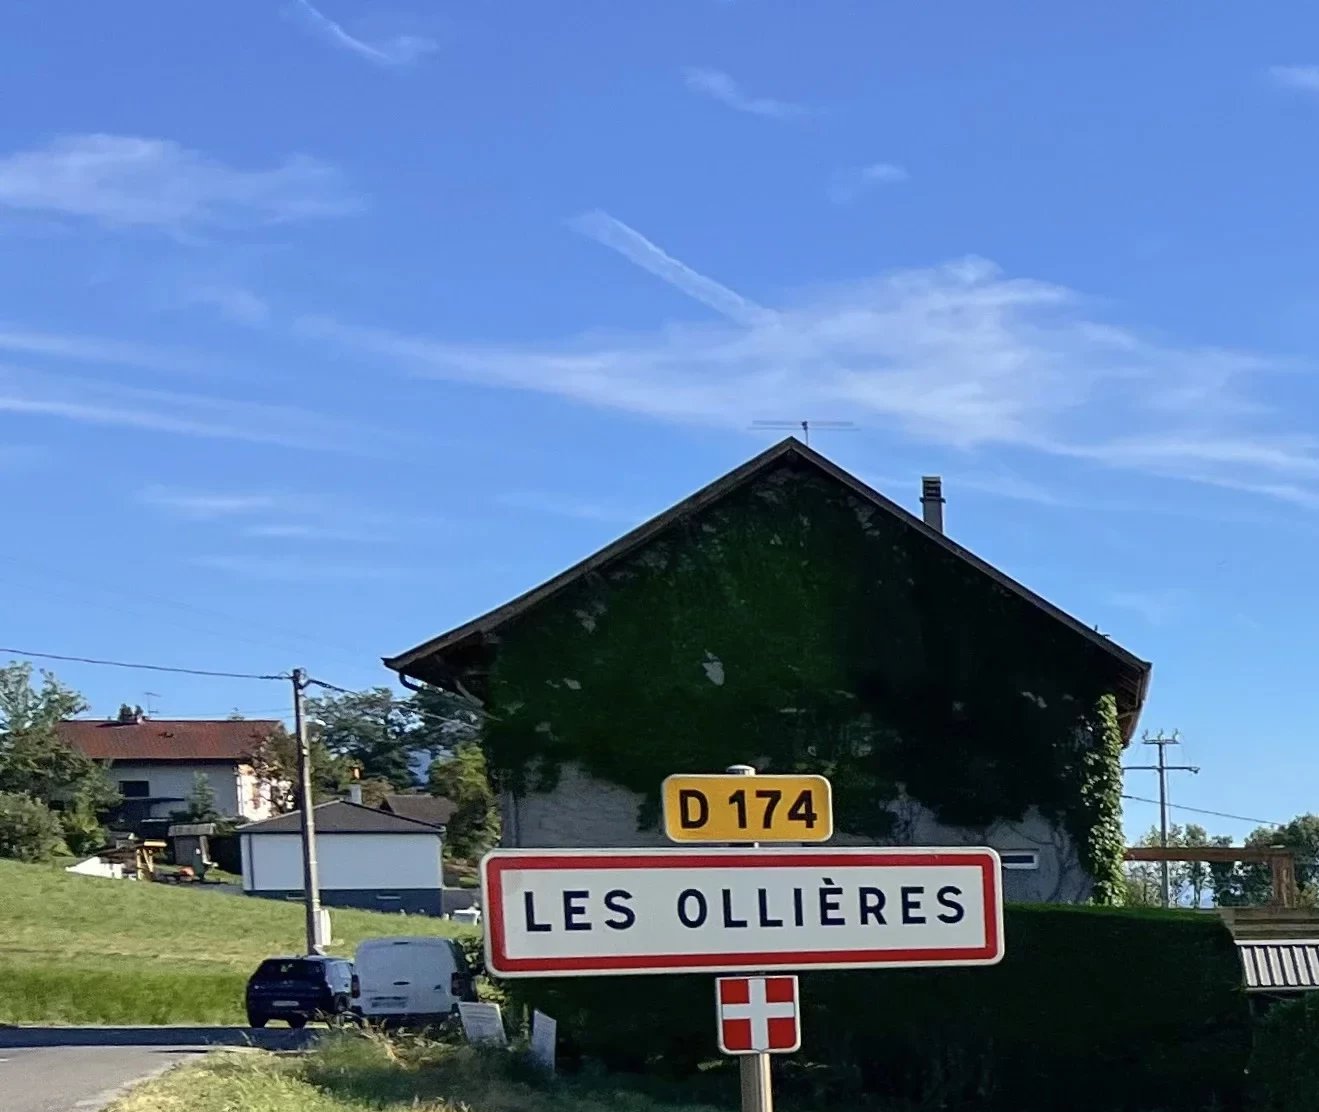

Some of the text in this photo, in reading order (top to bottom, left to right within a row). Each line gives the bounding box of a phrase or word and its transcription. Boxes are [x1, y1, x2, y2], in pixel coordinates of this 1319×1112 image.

[679, 789, 818, 829] D 174
[524, 877, 965, 932] LES OLLIÈRES
